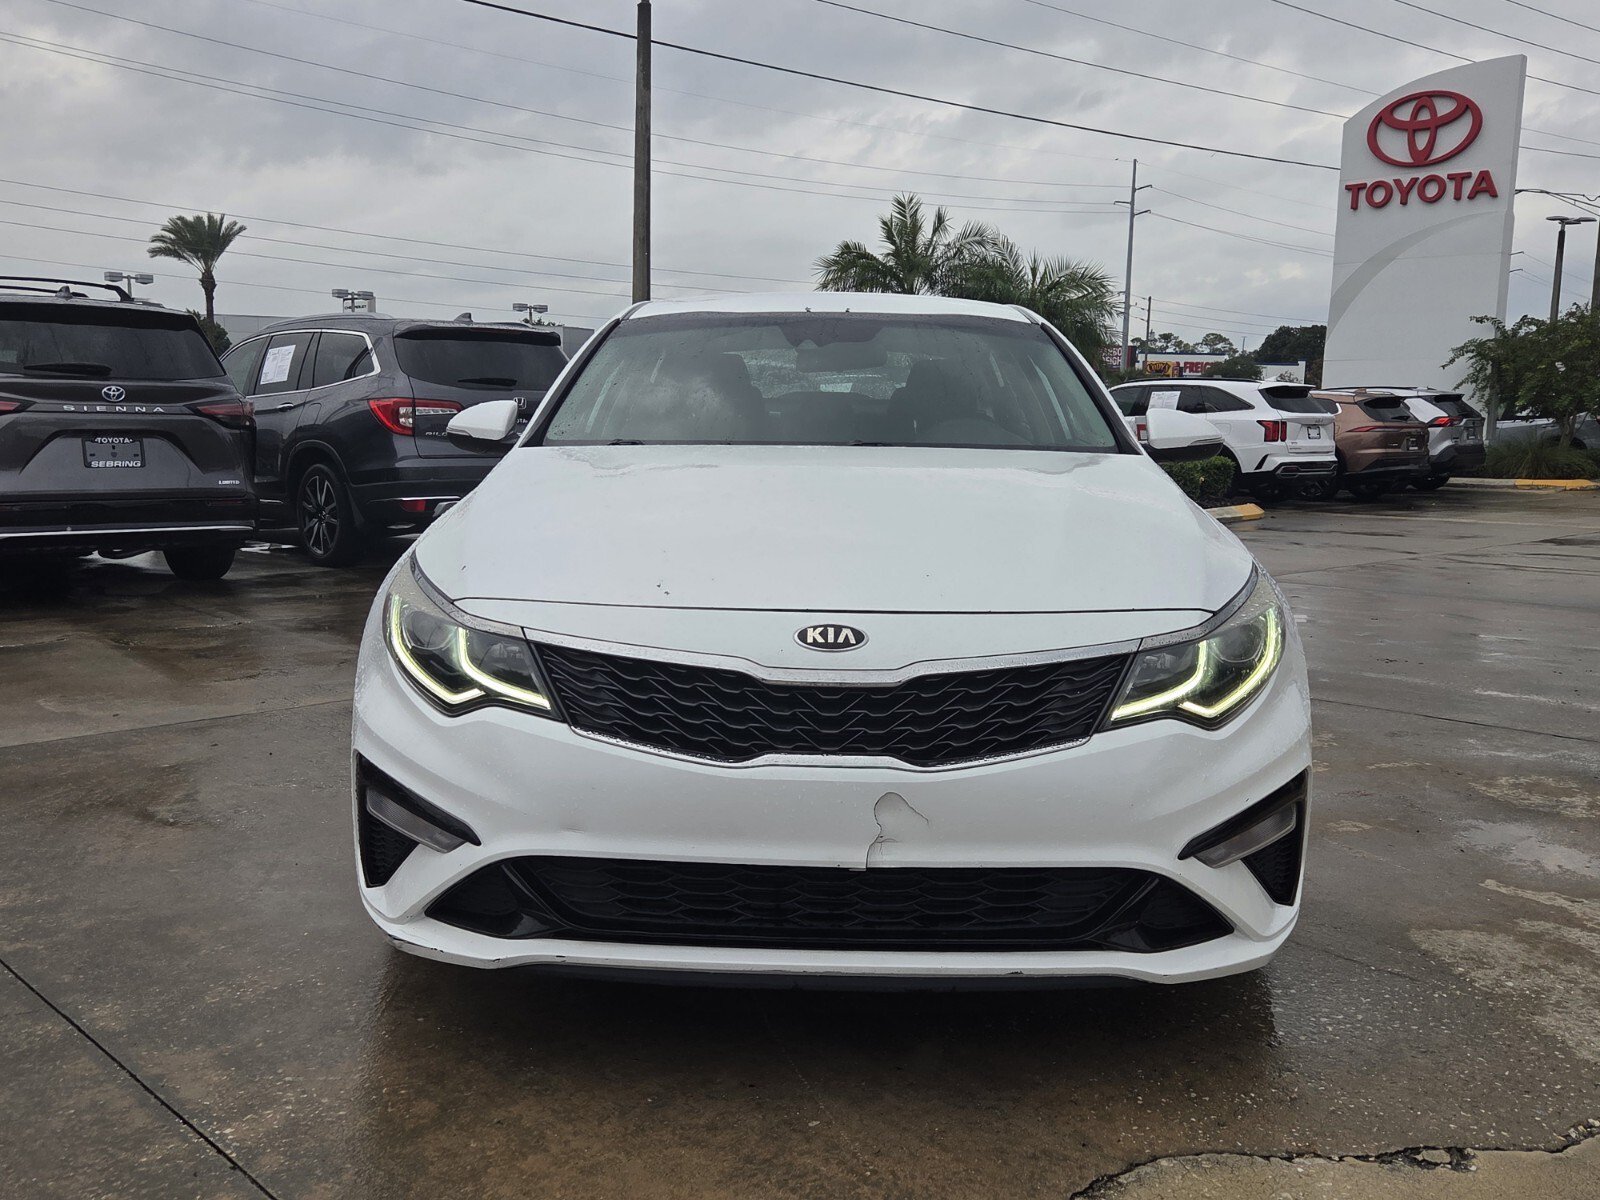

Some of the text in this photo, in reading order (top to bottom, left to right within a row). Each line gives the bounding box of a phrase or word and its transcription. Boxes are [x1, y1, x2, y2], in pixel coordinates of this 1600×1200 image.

[1345, 170, 1499, 210] TOYOTA
[90, 460, 142, 468] SEBRING
[806, 627, 857, 644] KIA
